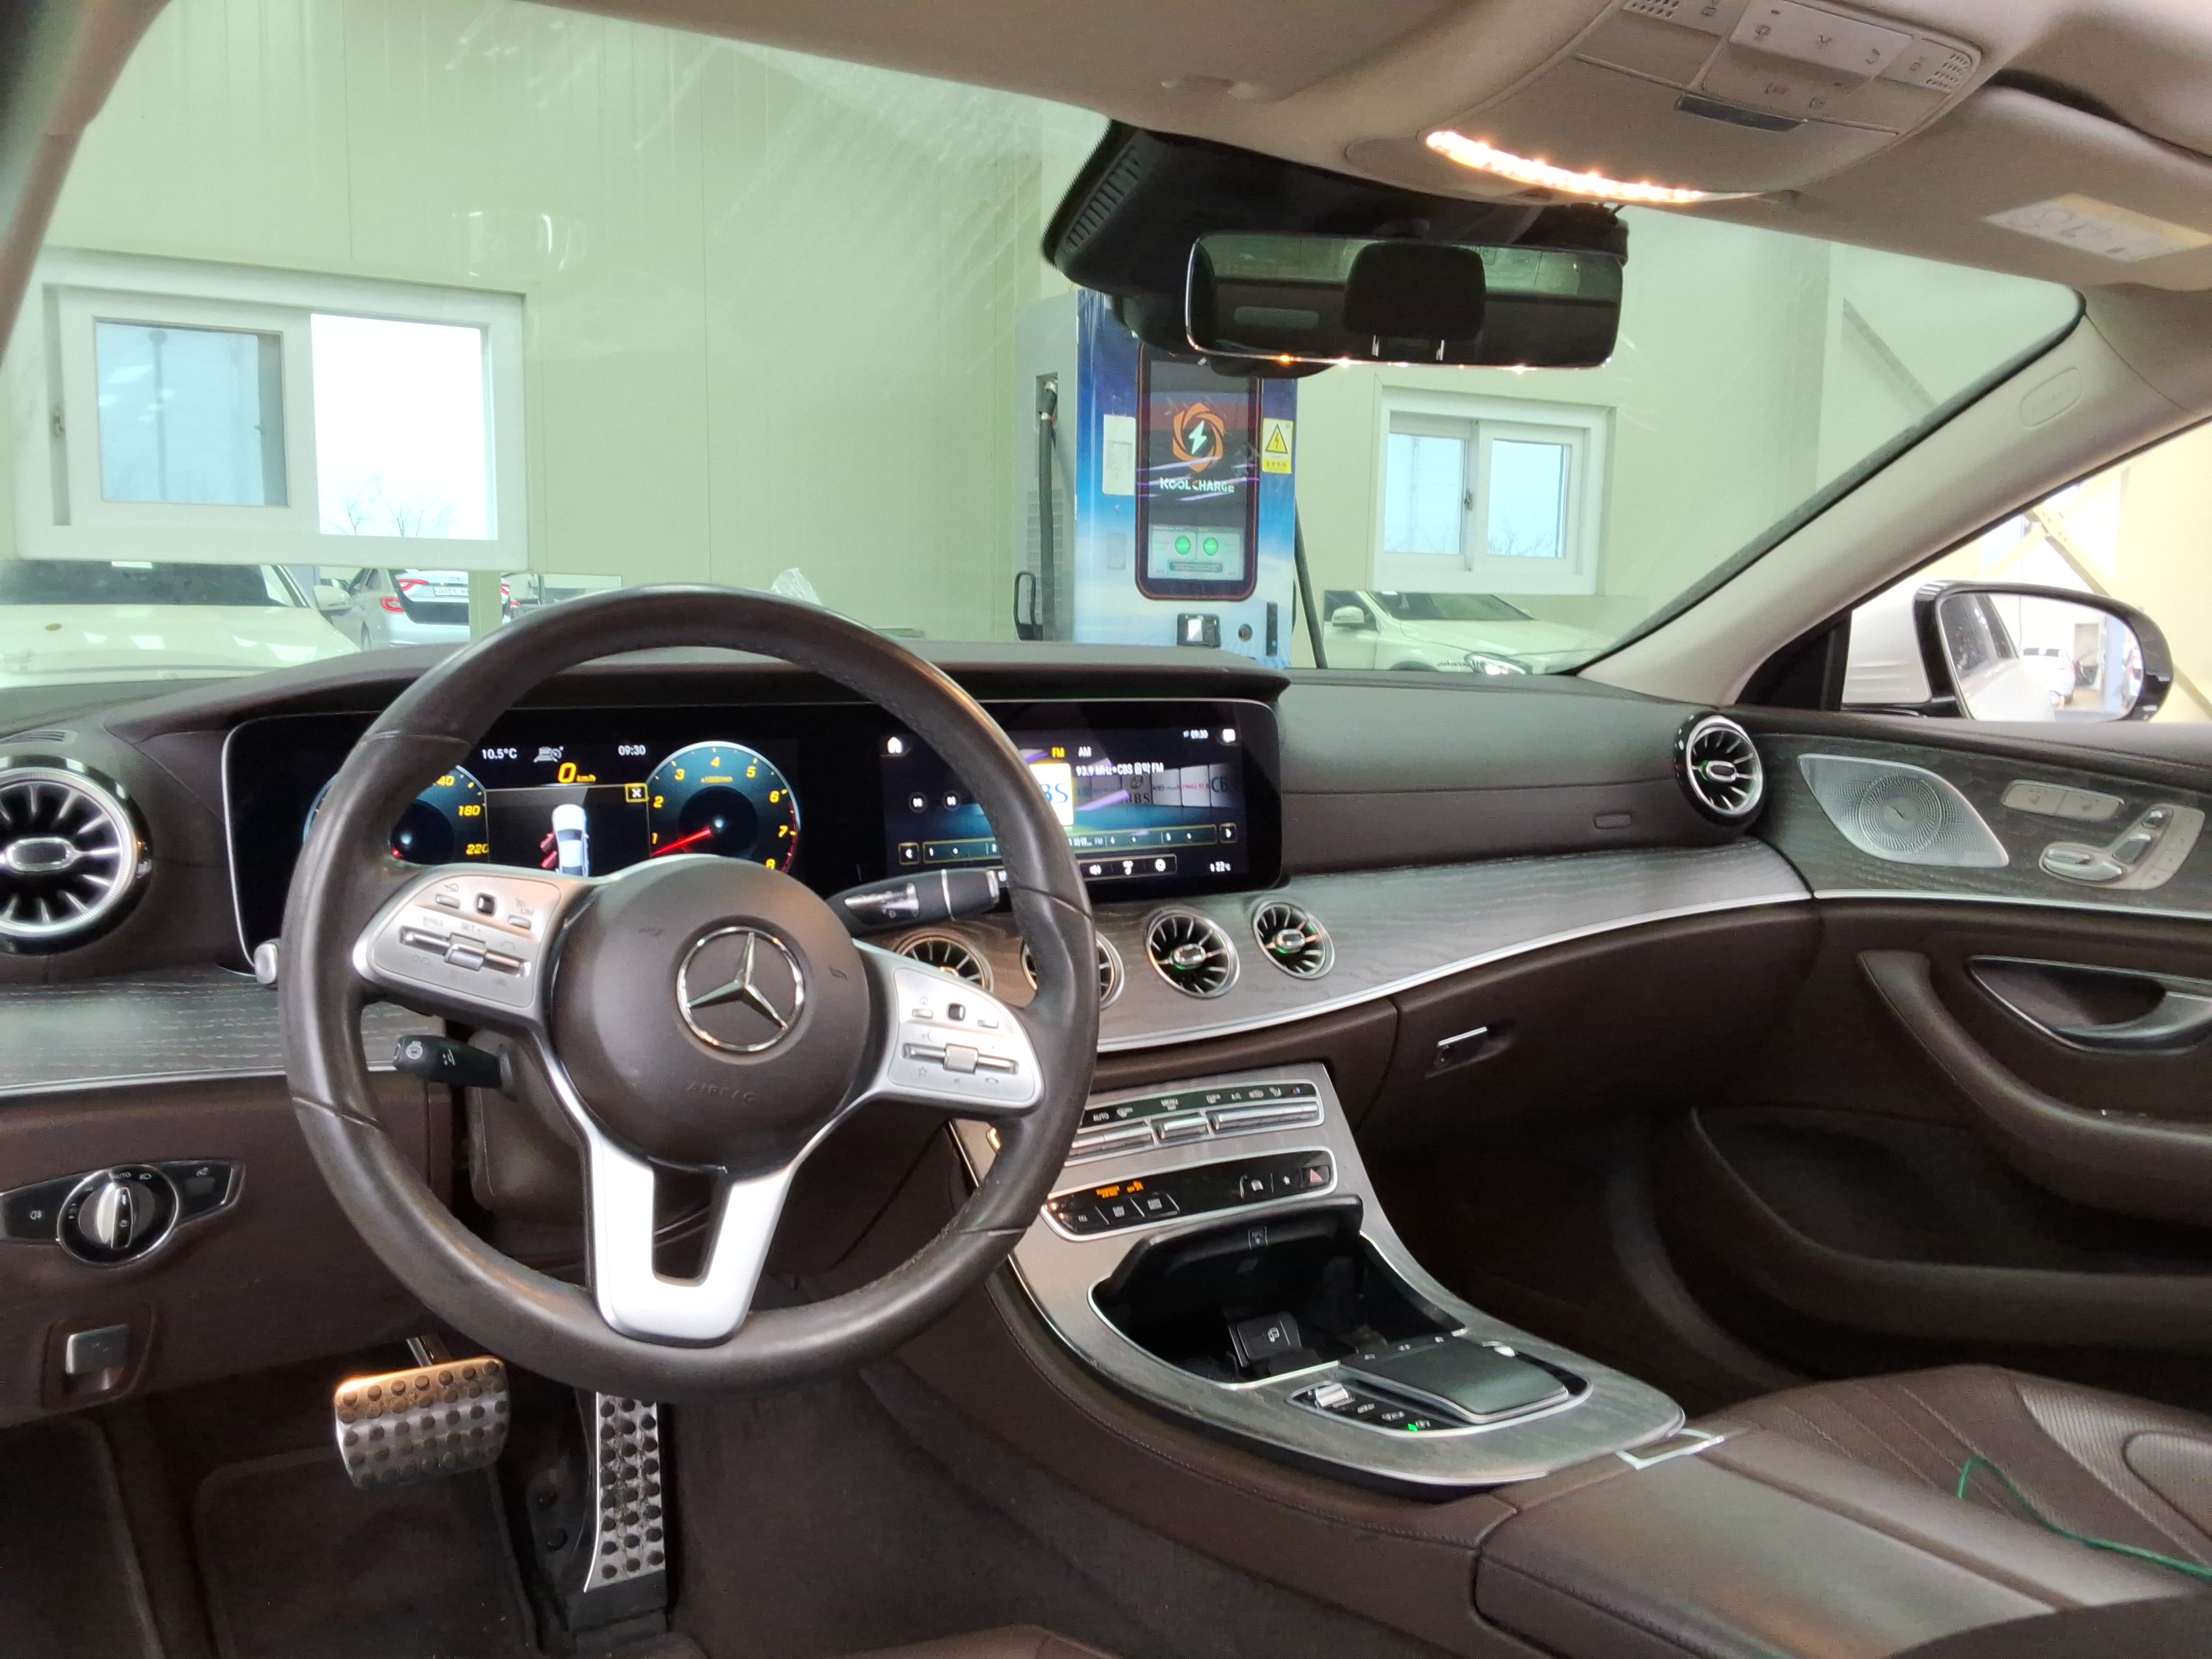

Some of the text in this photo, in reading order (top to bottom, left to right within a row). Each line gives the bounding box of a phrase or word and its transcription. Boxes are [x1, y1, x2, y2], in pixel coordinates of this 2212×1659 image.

[482, 748, 517, 760] 10.5°C
[618, 745, 647, 756] 09:30
[1052, 747, 1065, 758] FM
[1078, 746, 1092, 757] AM
[711, 756, 720, 767] 4
[558, 762, 576, 783] 0
[674, 769, 686, 781] 3
[746, 766, 757, 778] 5
[1076, 765, 1094, 777] 93.9
[1151, 762, 1164, 773] FM
[653, 795, 665, 808] 2
[769, 790, 779, 802] 6
[458, 804, 481, 817] 180
[779, 825, 788, 838] 7
[651, 832, 658, 844] 1
[466, 843, 489, 855] 220
[1092, 1112, 1110, 1122] AUTO
